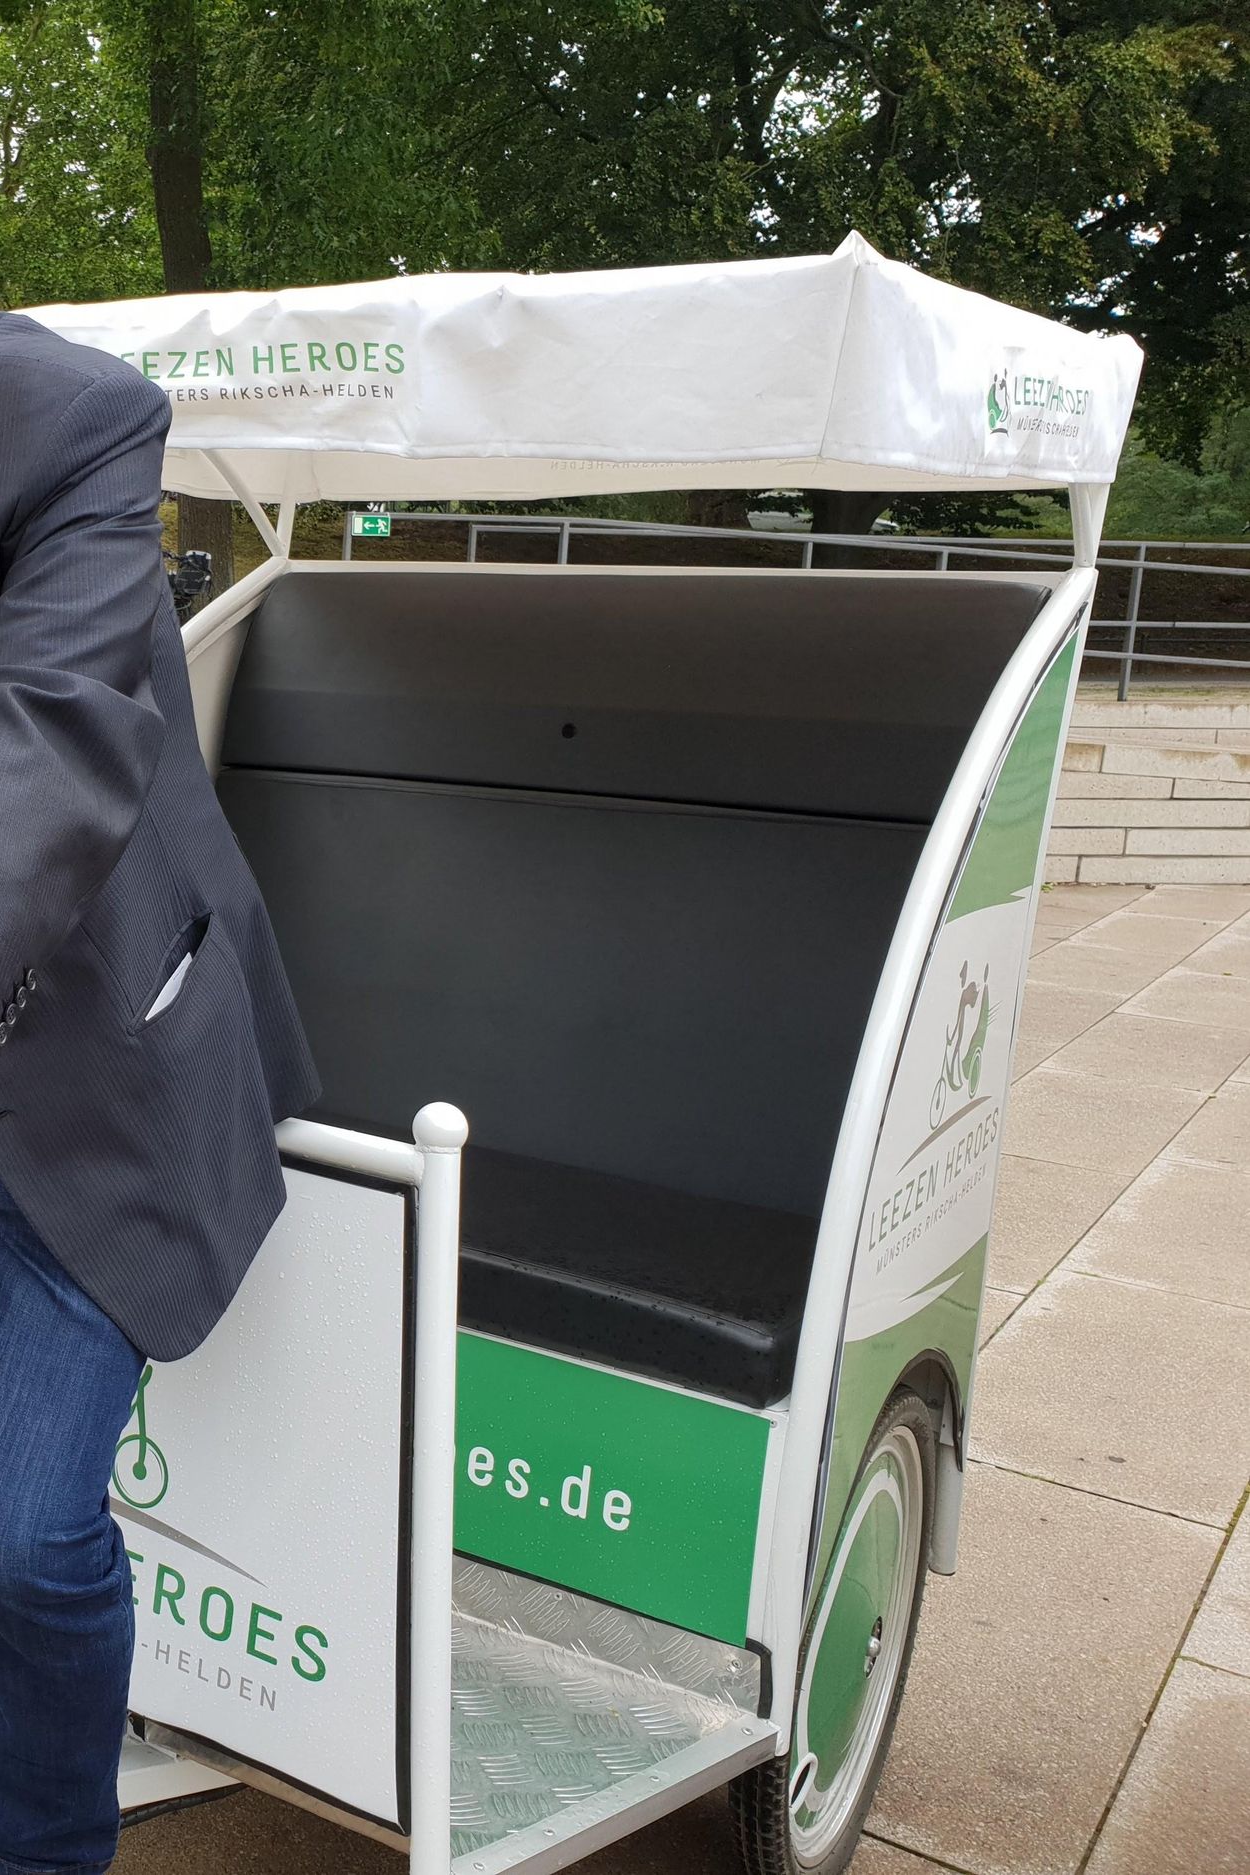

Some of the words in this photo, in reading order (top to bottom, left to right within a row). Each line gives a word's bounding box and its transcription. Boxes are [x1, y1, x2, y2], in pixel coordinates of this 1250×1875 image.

[252, 341, 405, 375] HEROES
[220, 383, 394, 401] RIKSCHA-HELDEN
[868, 1159, 940, 1252] LEEZEN
[943, 1106, 999, 1189] HEROES
[876, 1222, 923, 1275] MÜNSTERS
[467, 1446, 633, 1532] es.de
